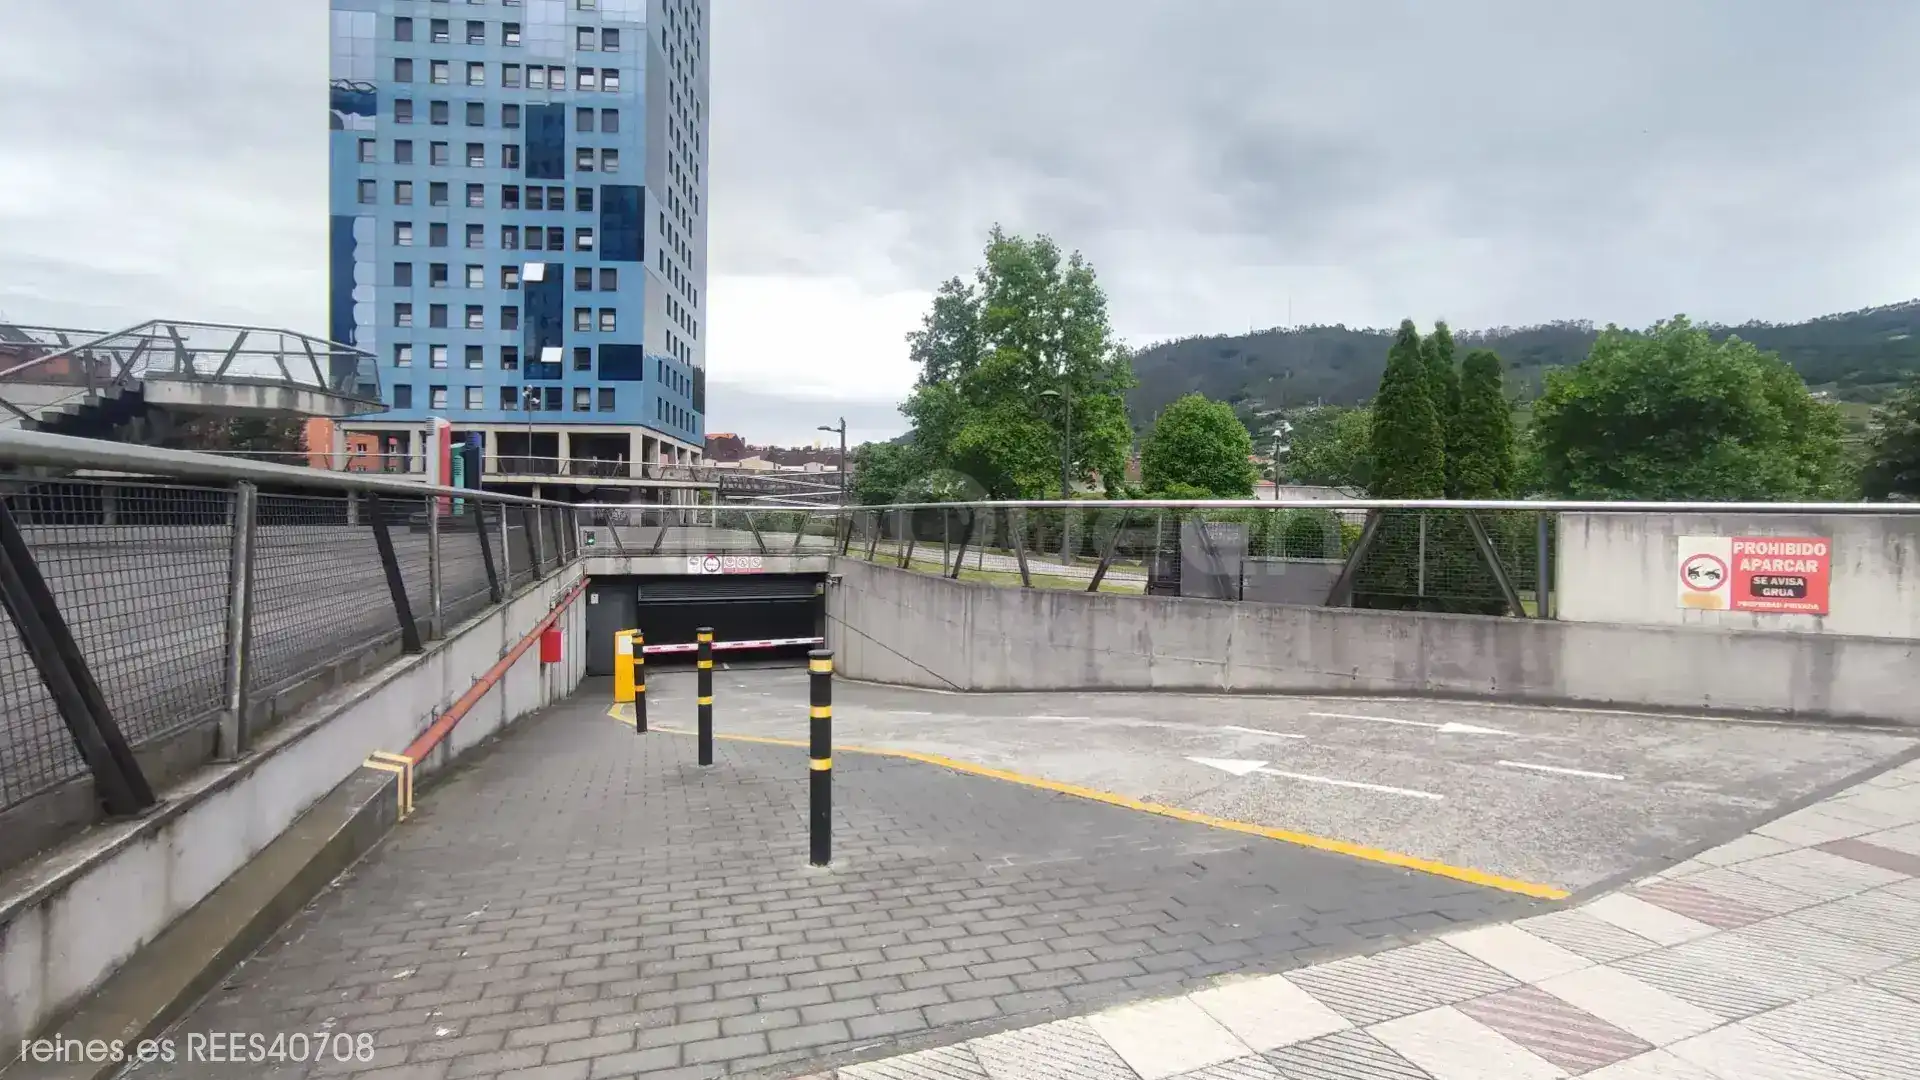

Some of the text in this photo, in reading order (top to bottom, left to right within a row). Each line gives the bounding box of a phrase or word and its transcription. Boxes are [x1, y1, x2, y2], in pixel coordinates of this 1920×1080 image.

[1733, 542, 1827, 556] PROHIBIDO
[1740, 558, 1819, 573] APARCAR
[1753, 576, 1804, 586] SE AVISA
[1762, 588, 1794, 597] GRUA
